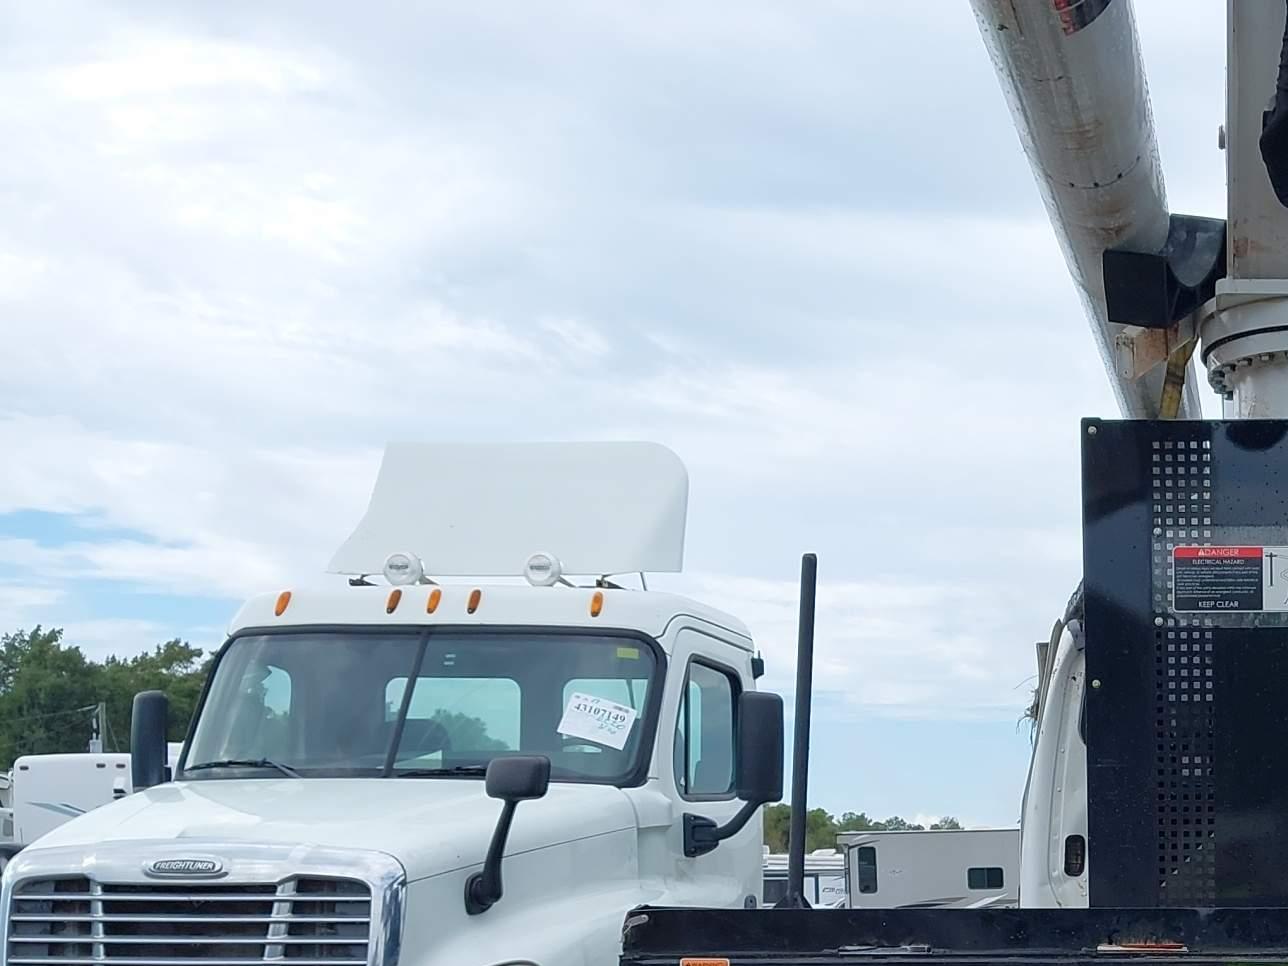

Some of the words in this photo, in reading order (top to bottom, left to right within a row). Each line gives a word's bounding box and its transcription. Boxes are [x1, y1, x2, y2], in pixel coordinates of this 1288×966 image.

[1203, 548, 1239, 556] DANGER
[1198, 600, 1215, 608] KEEP
[1216, 600, 1239, 608] CLEAR
[573, 703, 626, 722] 43107149
[154, 861, 214, 870] FREIGHTLINER
